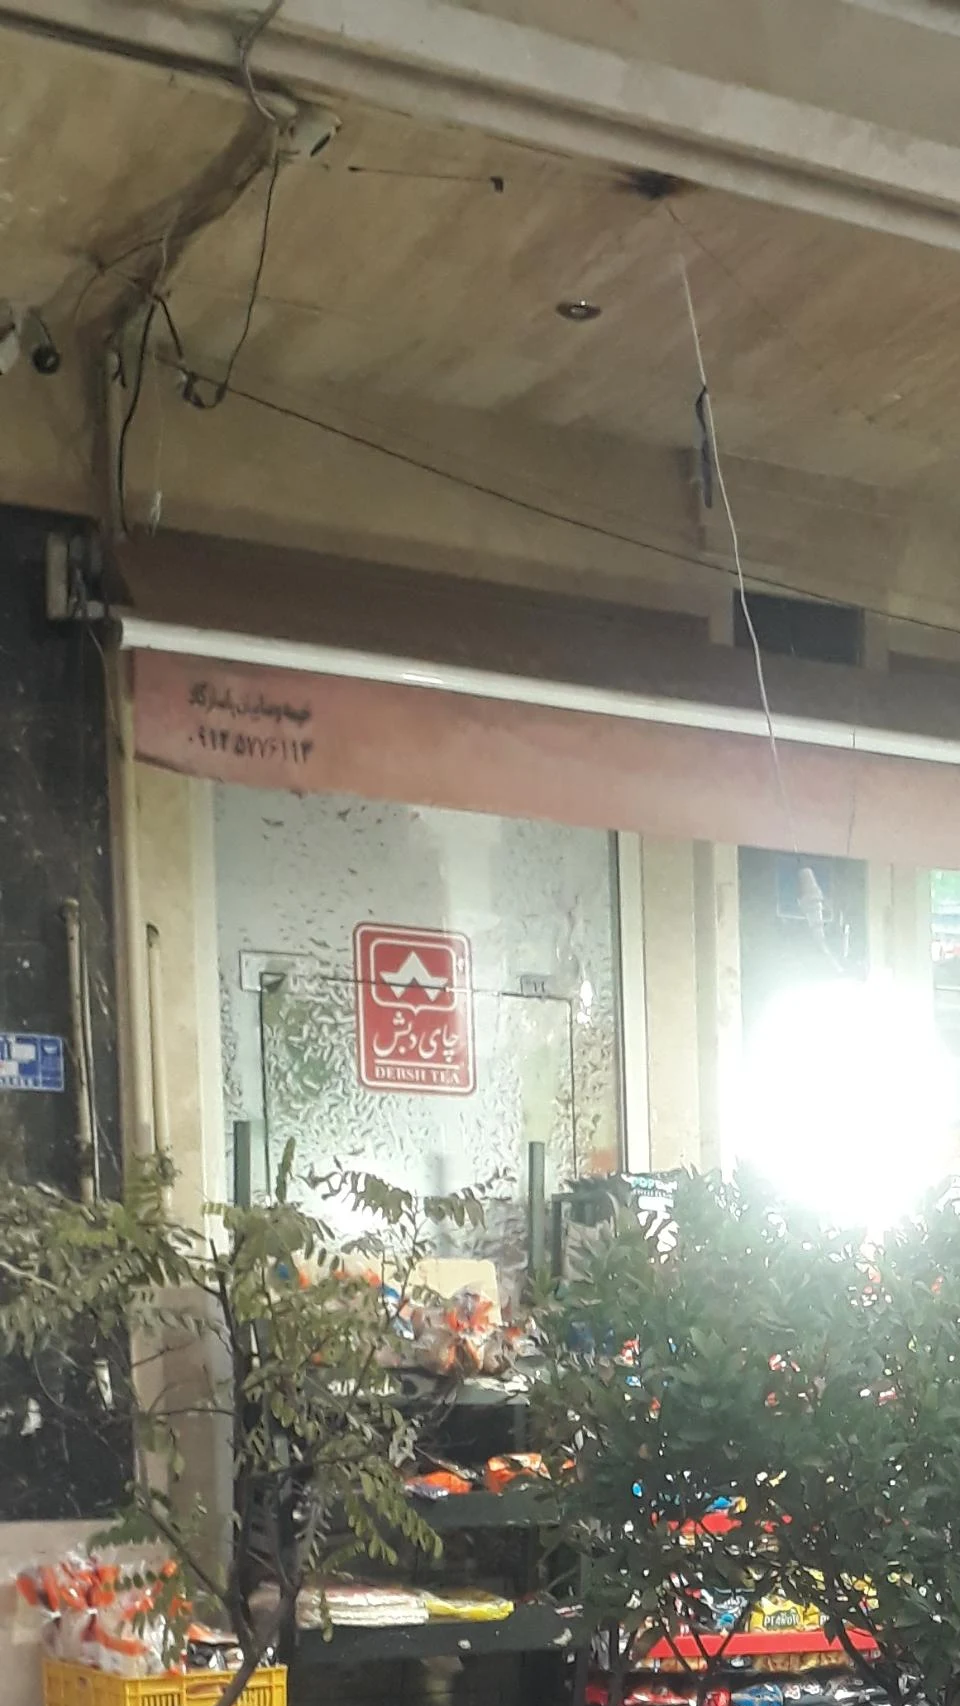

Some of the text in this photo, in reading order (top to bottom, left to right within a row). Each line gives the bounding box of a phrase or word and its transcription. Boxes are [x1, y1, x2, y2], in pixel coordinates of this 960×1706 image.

[373, 1011, 460, 1062] چای دبش
[375, 1066, 461, 1084] DEBSH TEA
